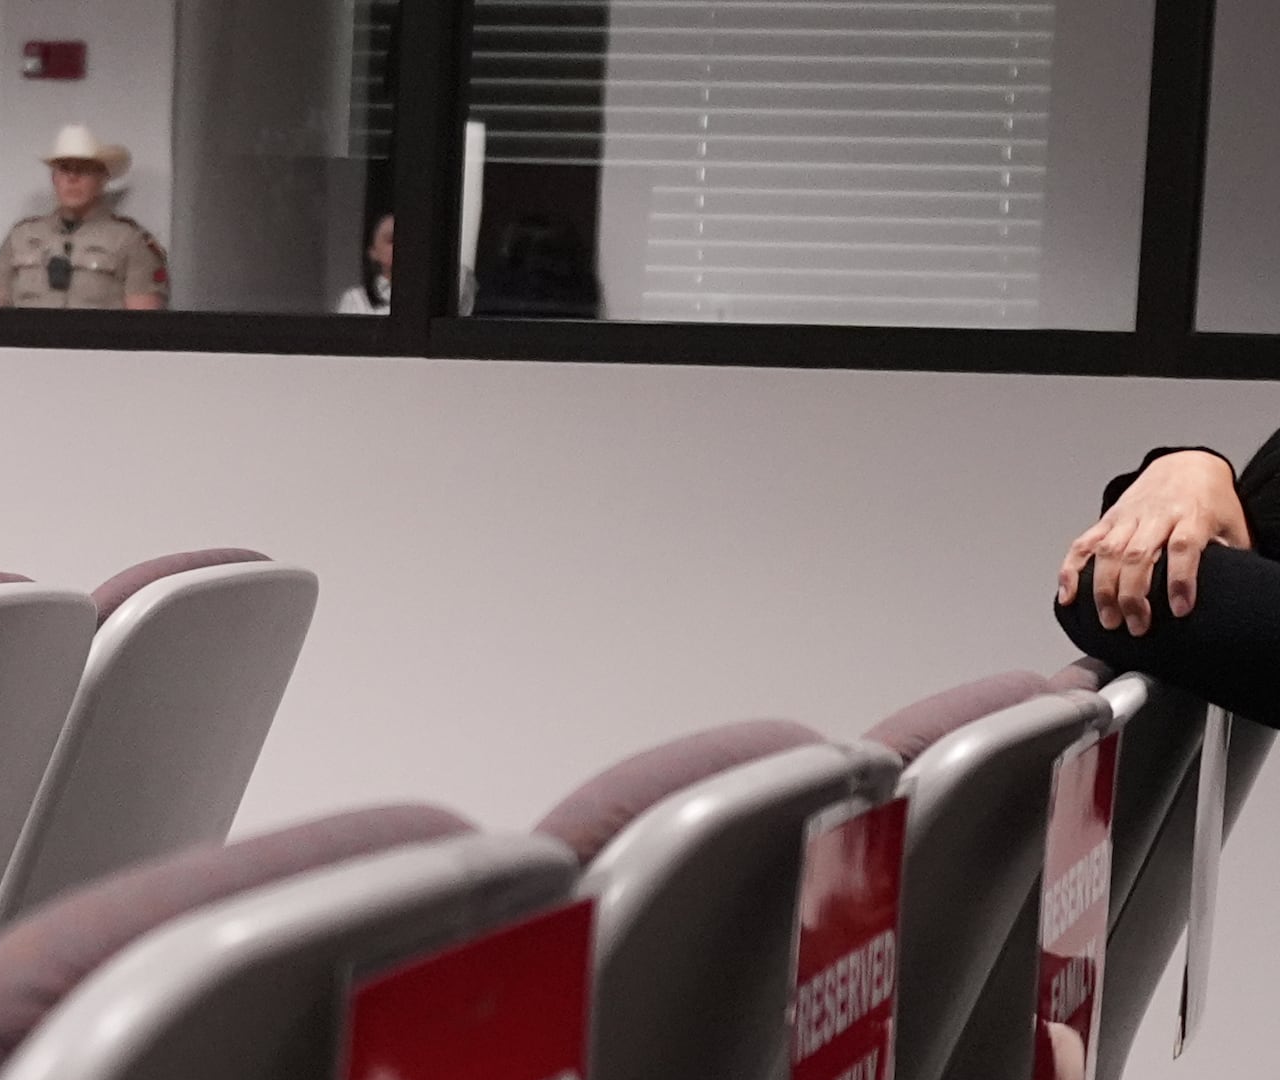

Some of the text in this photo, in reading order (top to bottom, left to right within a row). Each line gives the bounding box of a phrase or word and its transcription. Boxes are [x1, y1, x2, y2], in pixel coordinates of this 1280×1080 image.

[1043, 839, 1108, 949] RESERVED
[792, 929, 896, 1065] RESERVED
[1050, 934, 1097, 1025] FAMILY
